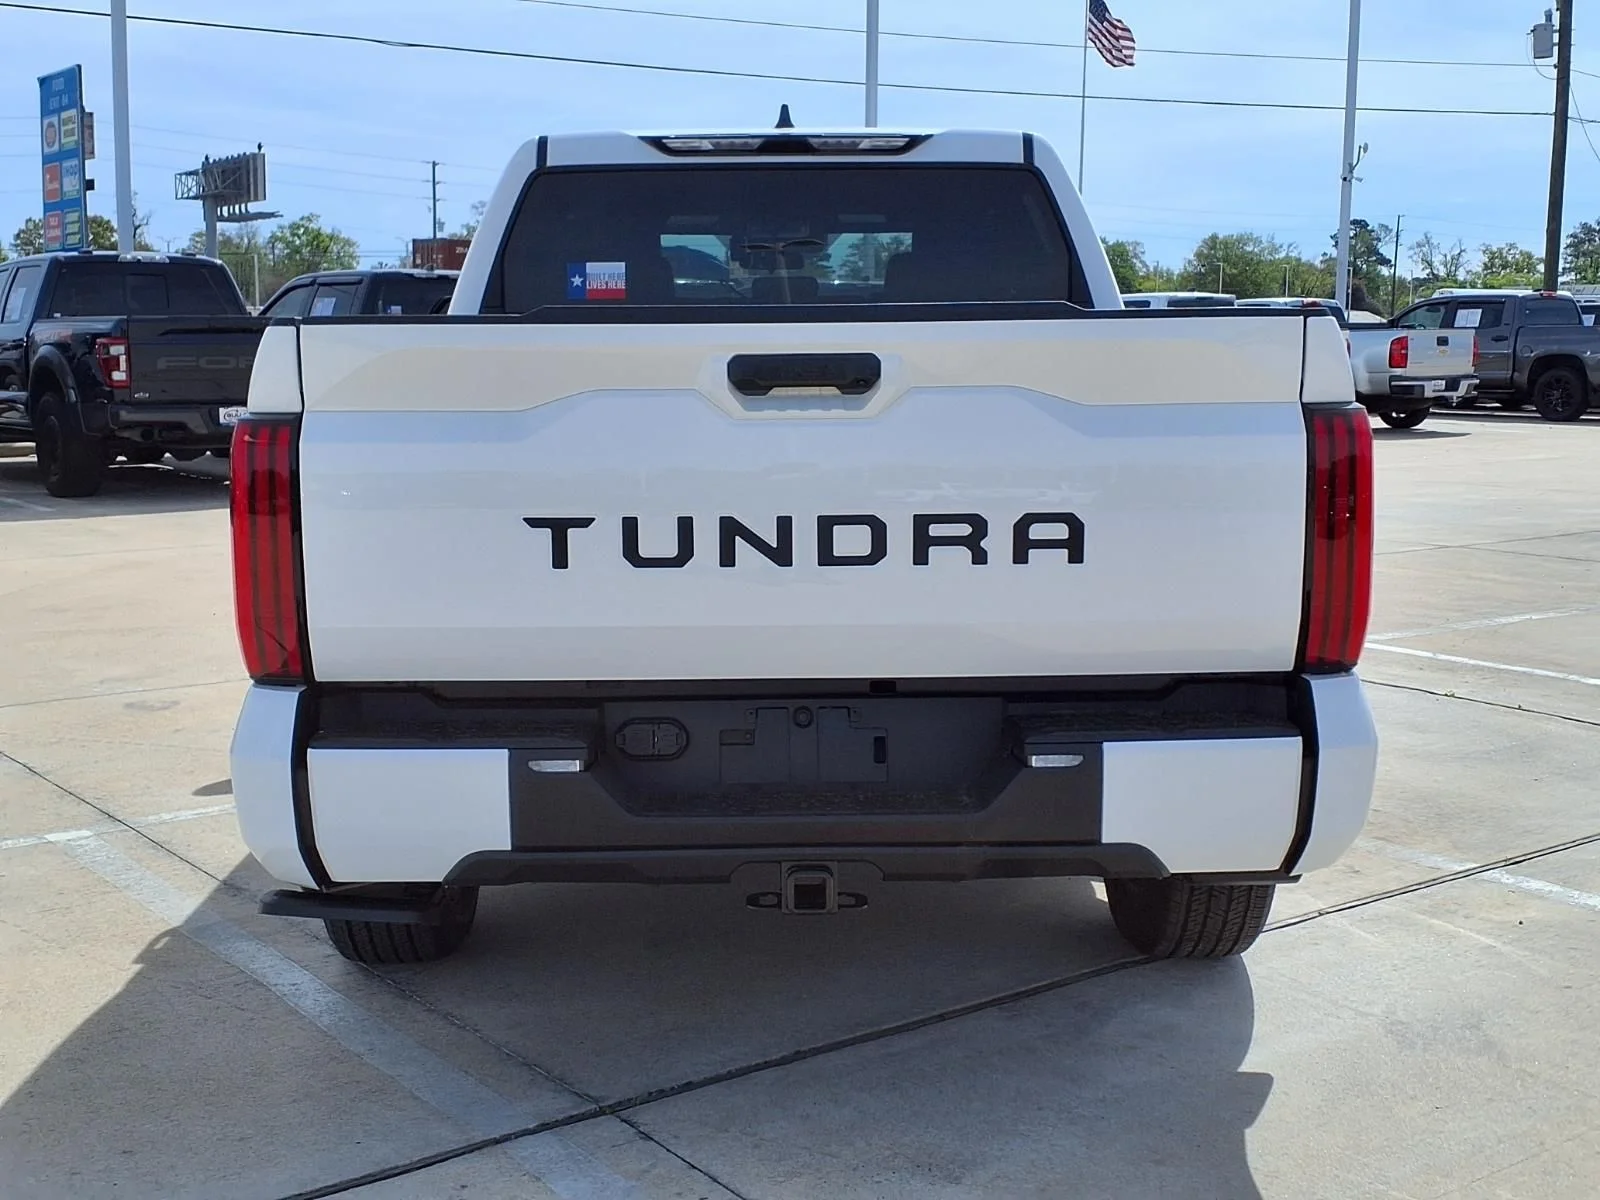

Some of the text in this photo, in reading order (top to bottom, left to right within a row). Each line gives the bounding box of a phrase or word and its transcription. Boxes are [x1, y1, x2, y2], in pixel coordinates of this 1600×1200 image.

[607, 272, 626, 281] HERE
[586, 280, 626, 289] LIVES HERE
[522, 511, 1086, 570] TUNDRA
